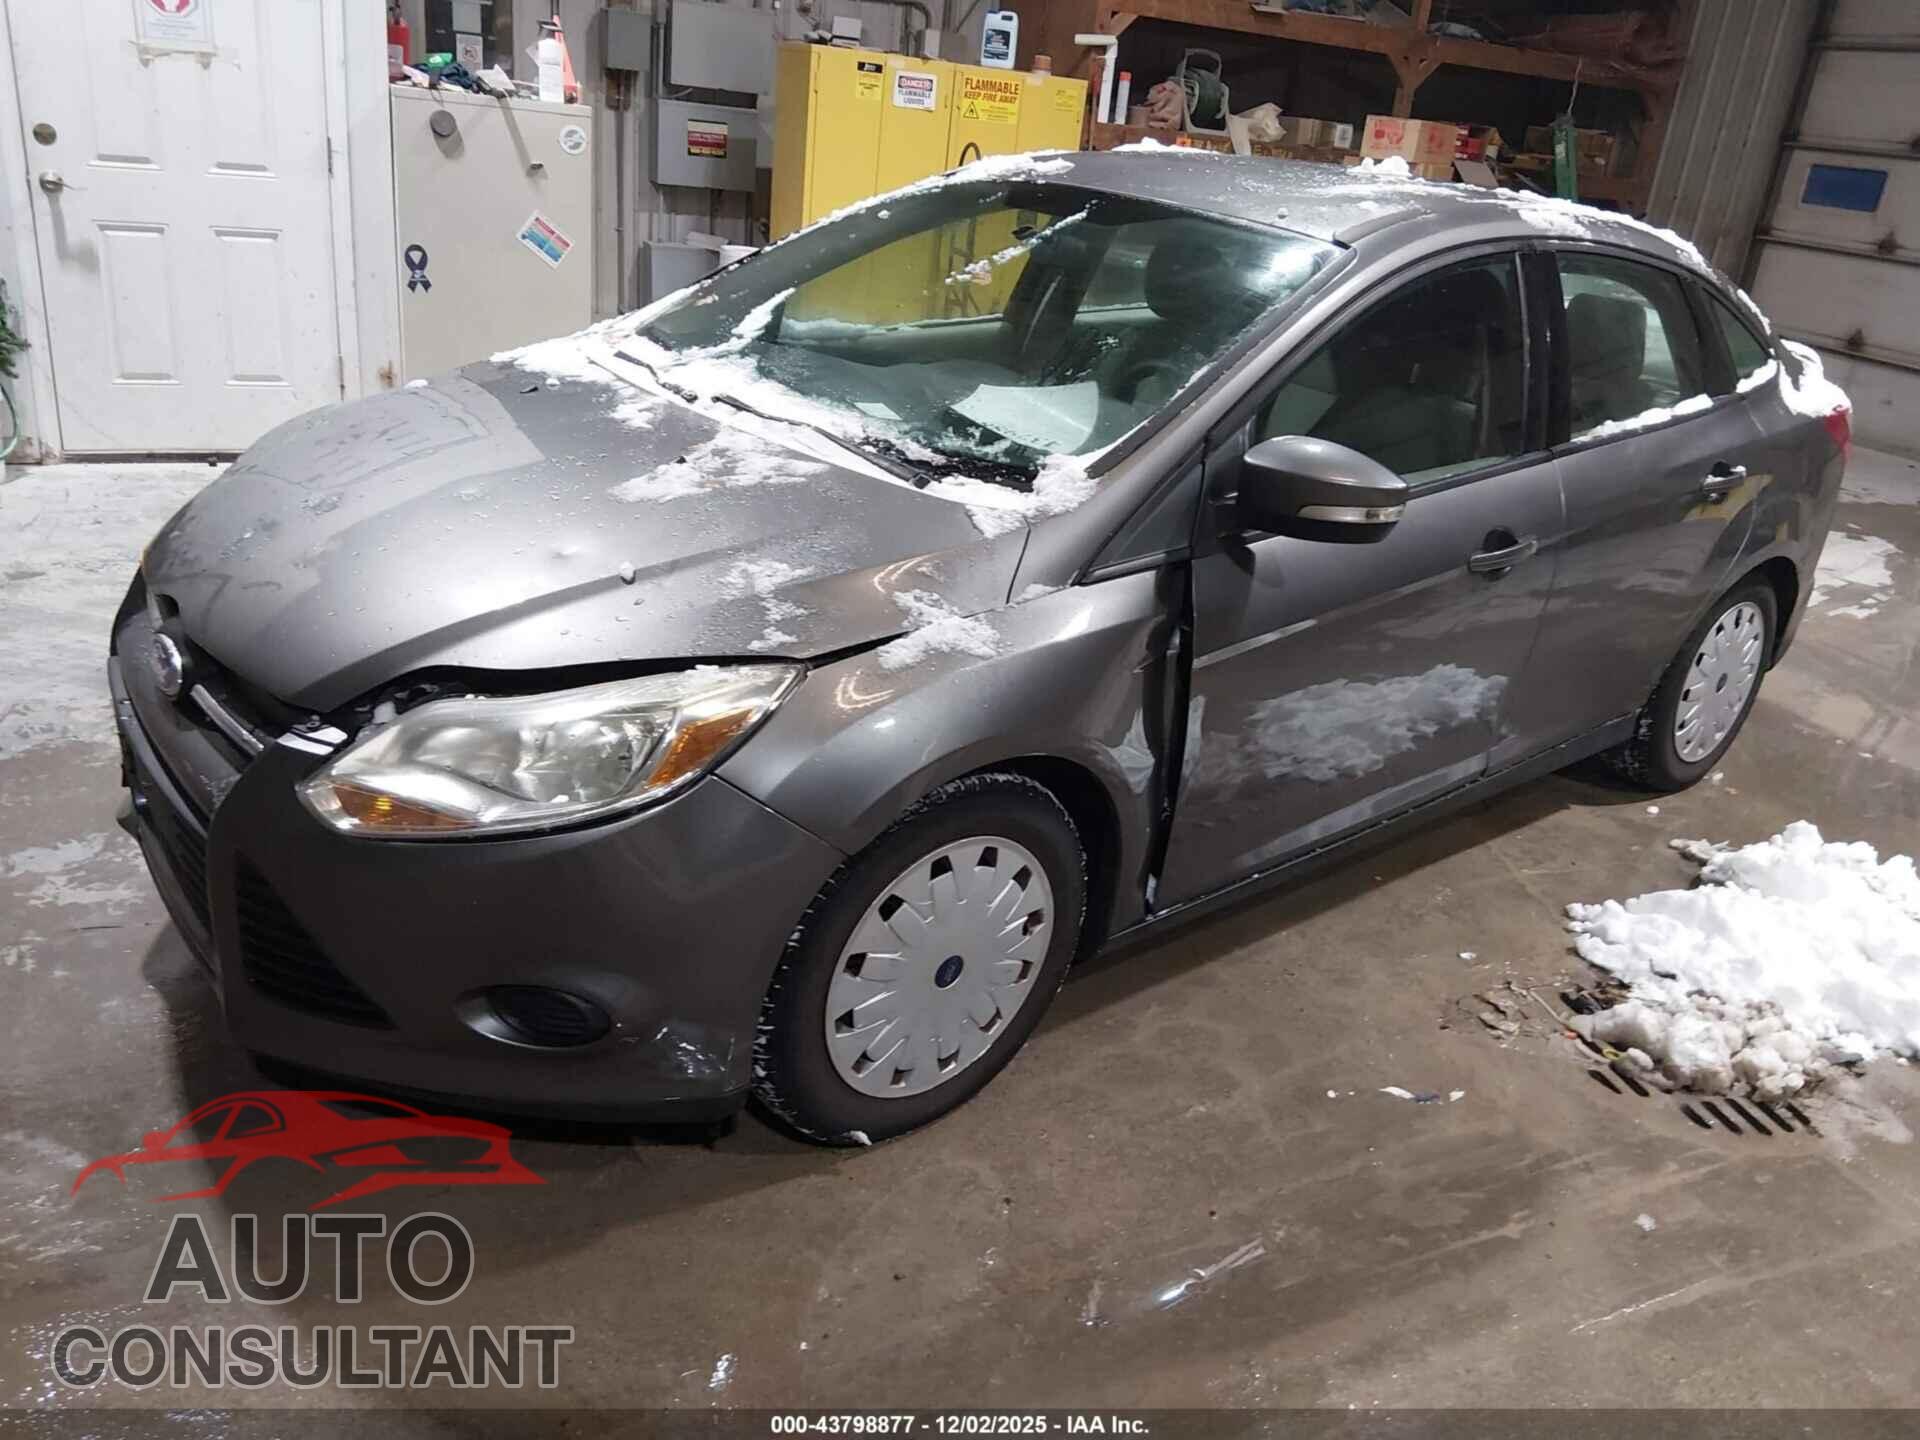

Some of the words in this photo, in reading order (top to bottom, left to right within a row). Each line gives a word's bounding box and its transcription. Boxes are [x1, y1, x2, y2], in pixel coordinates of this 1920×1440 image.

[899, 77, 932, 90] DANGER
[965, 78, 1019, 95] FLAMMABLE
[898, 90, 932, 99] FLAMMABLE
[964, 90, 981, 100] KEEP
[983, 92, 997, 102] FIRE
[998, 95, 1017, 104] AWAY
